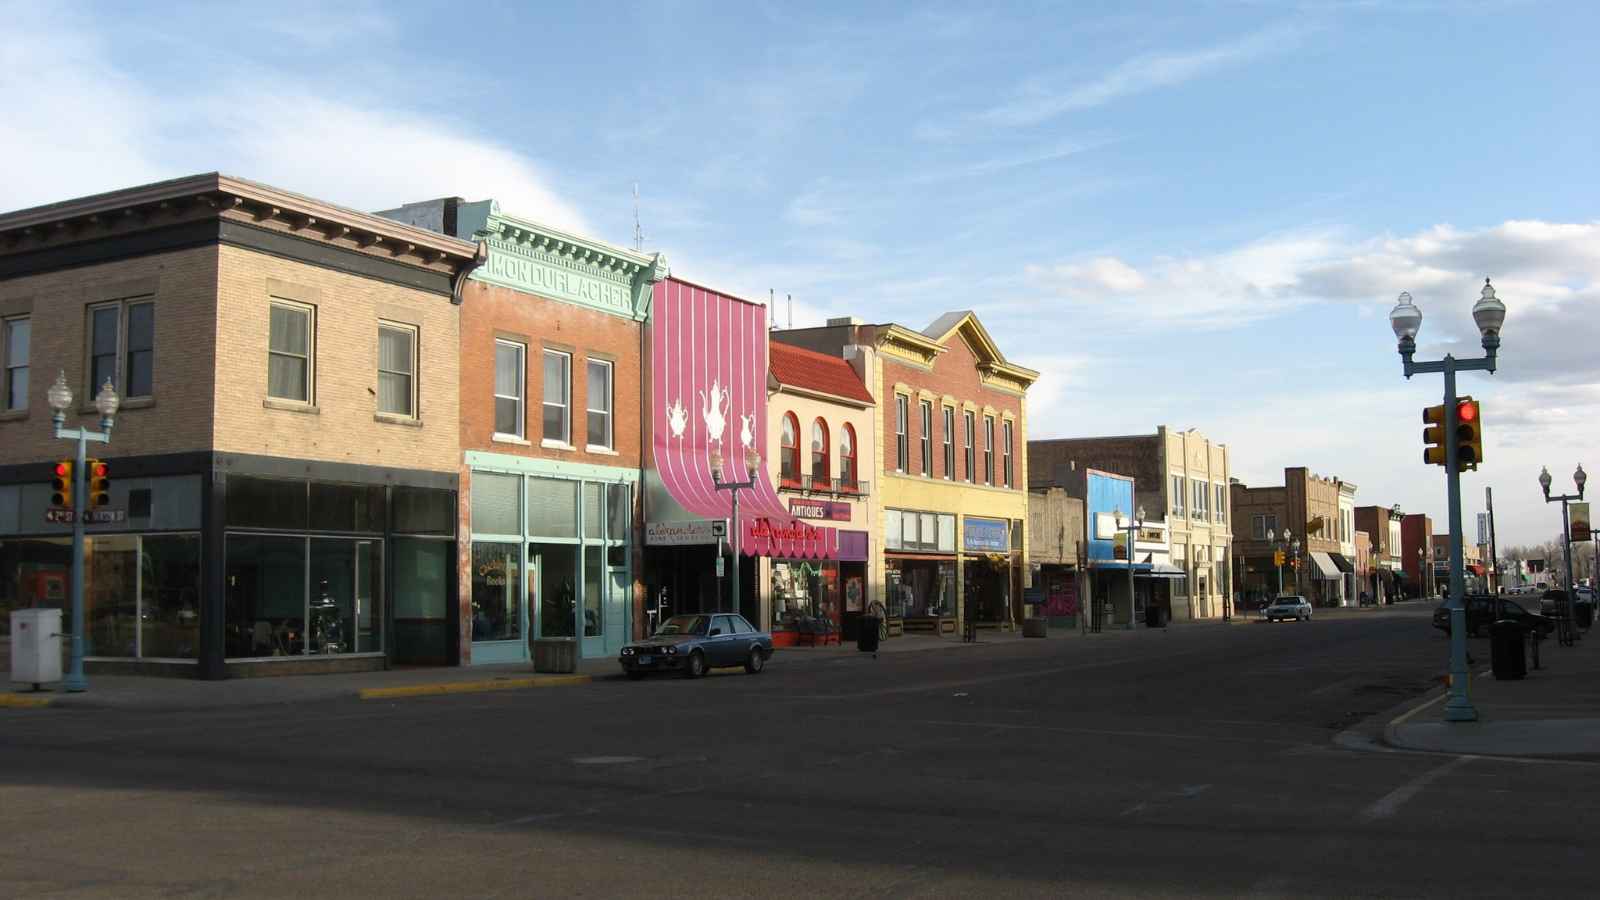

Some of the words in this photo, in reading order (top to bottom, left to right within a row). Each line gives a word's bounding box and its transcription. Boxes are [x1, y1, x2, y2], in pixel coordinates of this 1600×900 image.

[487, 253, 527, 282] IMON
[530, 264, 631, 311] DURLACHER
[791, 504, 824, 518] ANTIQUES
